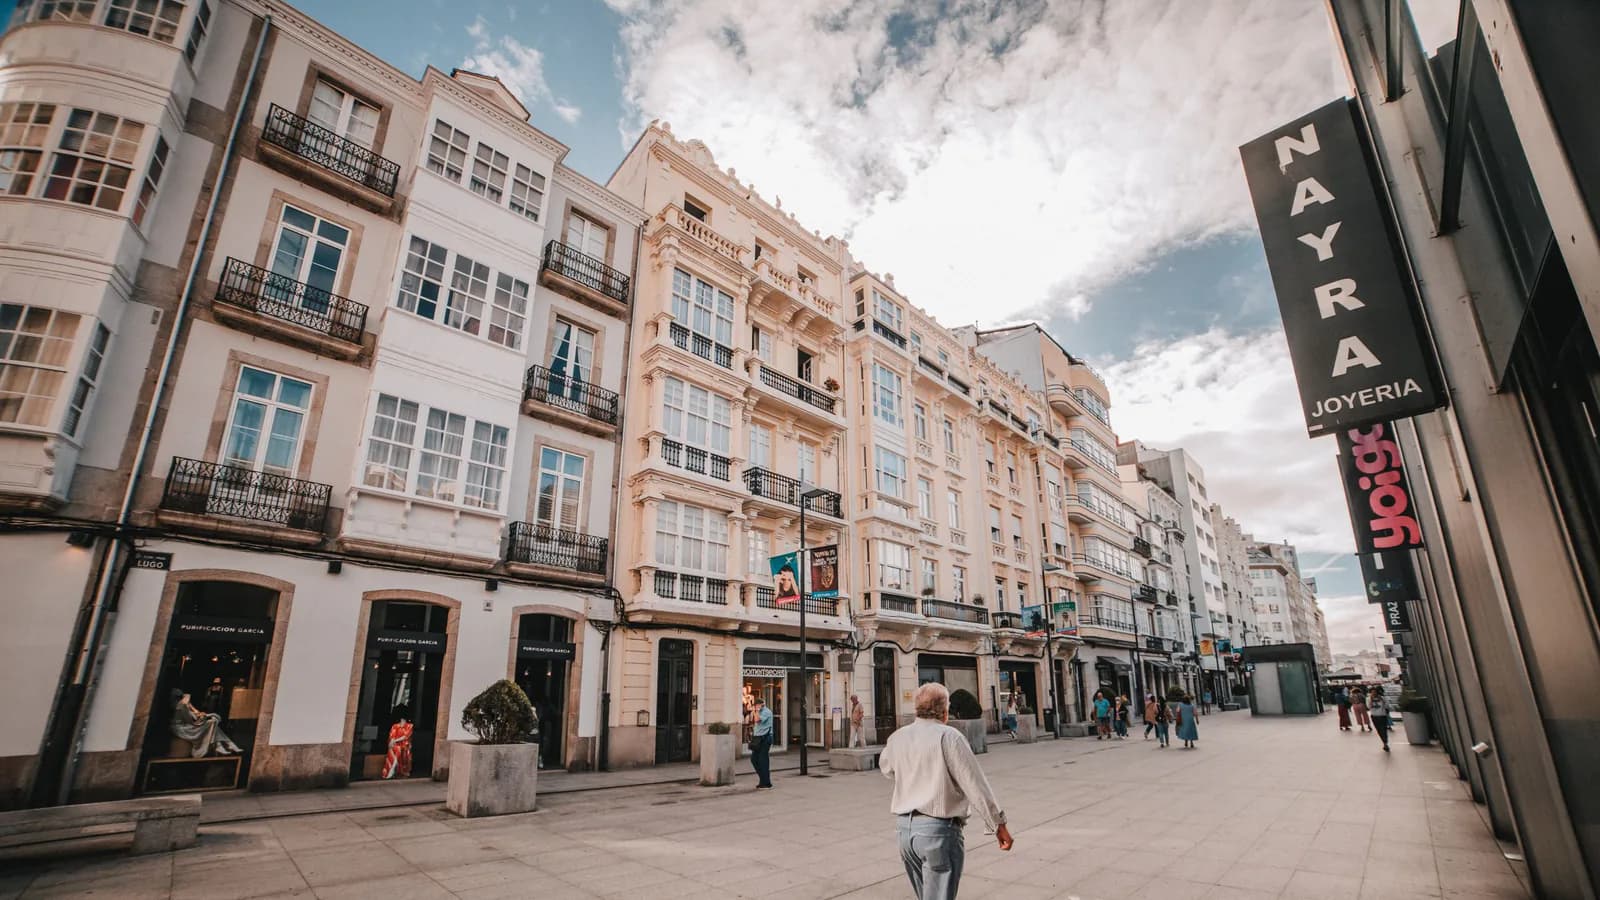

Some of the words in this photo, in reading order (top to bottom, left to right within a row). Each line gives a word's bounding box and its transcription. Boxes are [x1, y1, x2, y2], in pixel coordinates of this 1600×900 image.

[1274, 123, 1382, 378] NAYRA
[1311, 378, 1423, 418] JOYERIA
[137, 560, 164, 569] LUGO
[181, 624, 236, 633] PURIFICACION
